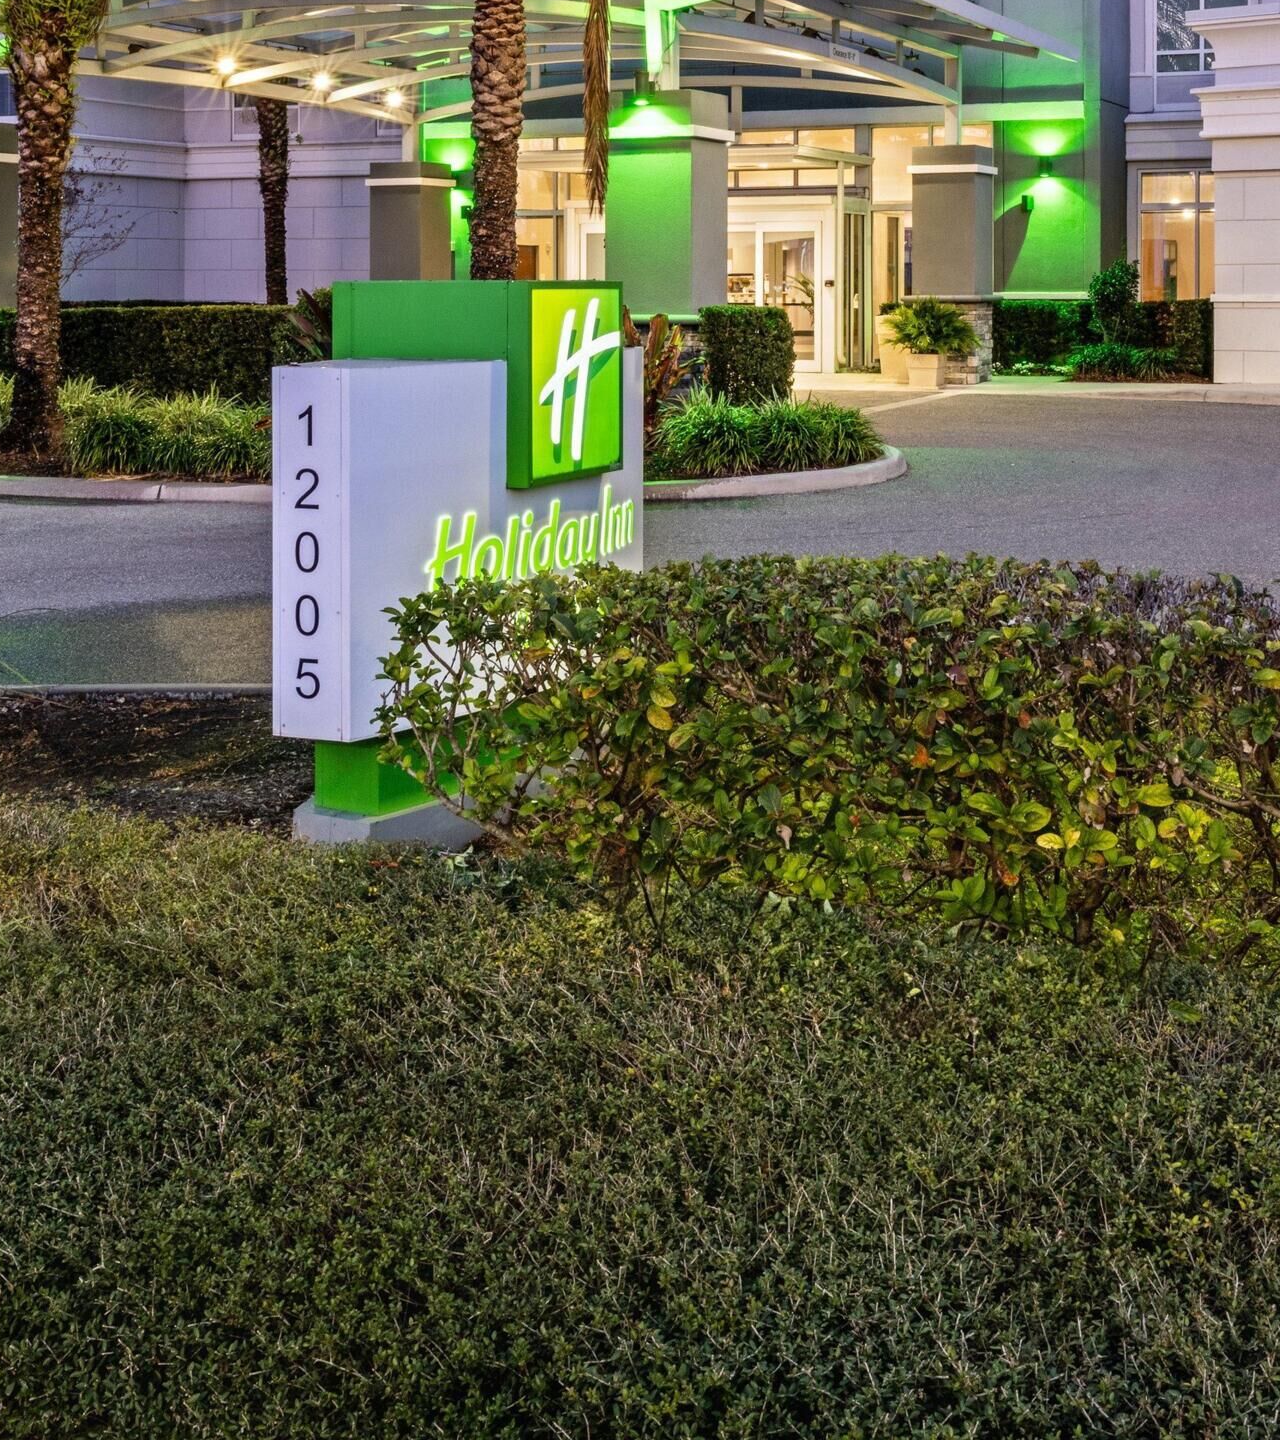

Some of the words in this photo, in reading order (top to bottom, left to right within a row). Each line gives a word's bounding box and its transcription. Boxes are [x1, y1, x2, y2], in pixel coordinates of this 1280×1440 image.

[294, 404, 321, 700] 12005
[424, 498, 600, 592] Holiday
[600, 483, 634, 556] Inn
